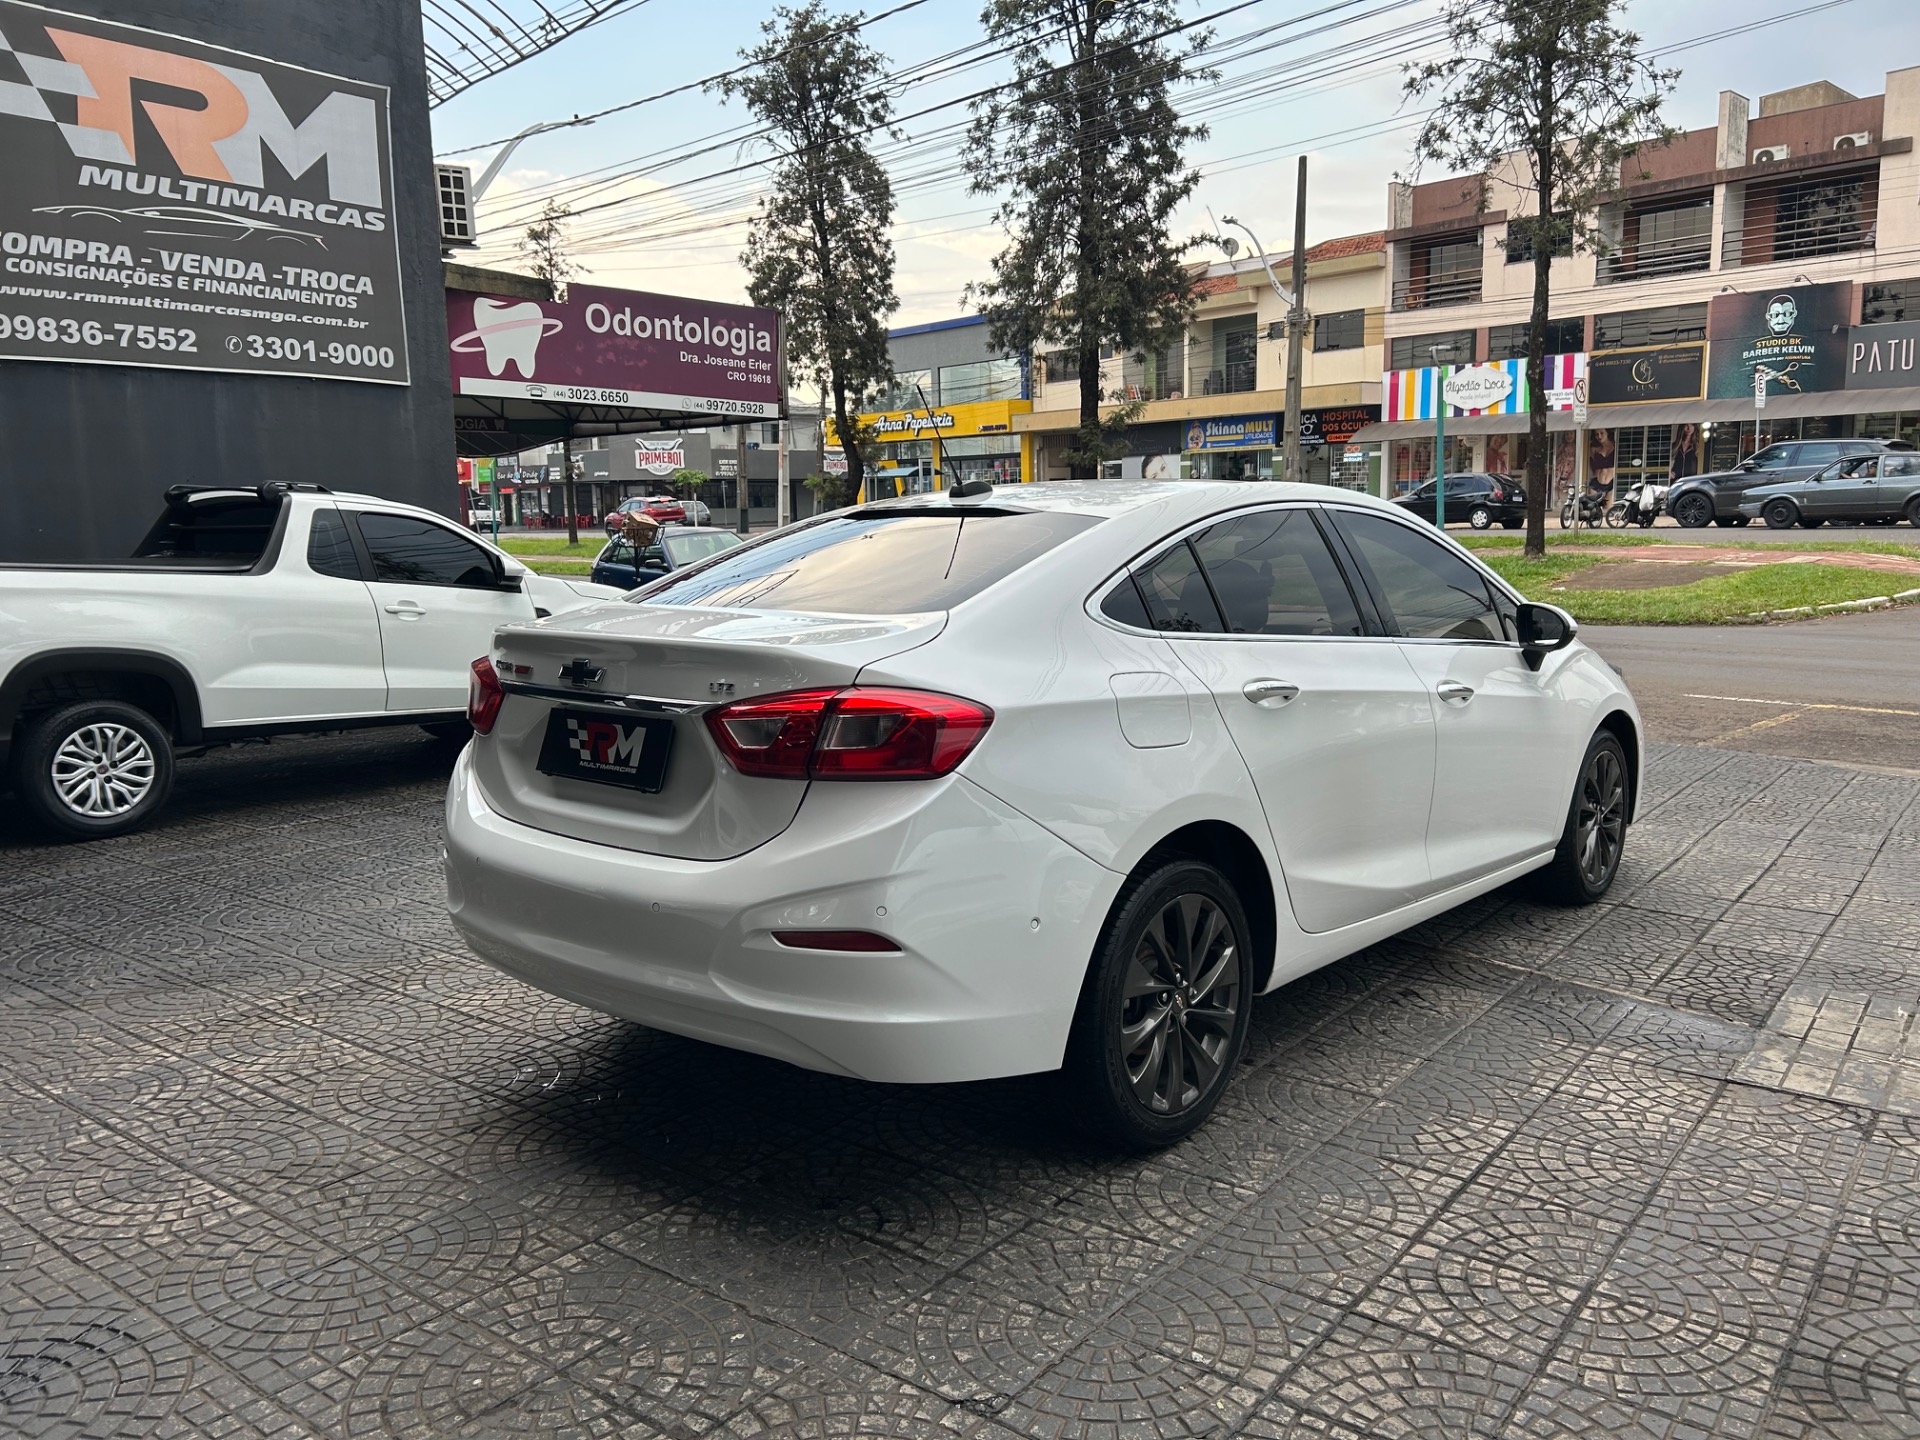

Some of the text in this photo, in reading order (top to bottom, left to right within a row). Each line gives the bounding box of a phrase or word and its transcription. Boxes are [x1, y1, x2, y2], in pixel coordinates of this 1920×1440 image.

[44, 26, 383, 209] RM
[79, 165, 386, 232] MULTIMARCAS
[0, 231, 134, 267] OMPRA
[160, 250, 267, 282] VENDA
[6, 257, 358, 309] CONSIGNAÇÕES E FINANCIAMENTOS
[585, 302, 772, 356] Odontologia
[246, 334, 395, 369] 3301-9000
[1743, 345, 1815, 360] BARBER KELVIN
[1756, 337, 1802, 349] STUDIO BK
[680, 351, 772, 372] Dra. Joseane Erler
[1852, 338, 1915, 374] PATU
[727, 371, 772, 385] CRO 19618
[1446, 378, 1506, 394] Algodão Doce
[554, 388, 764, 415] (44) 3023.6650 (44) 99720.5928
[873, 415, 904, 435] Anna
[1322, 410, 1369, 421] HOSPITAL
[1322, 423, 1339, 432] DOS
[639, 452, 682, 468] PRIMEBOI
[584, 721, 647, 768] RM
[579, 760, 637, 774] MULTIMARCAS
